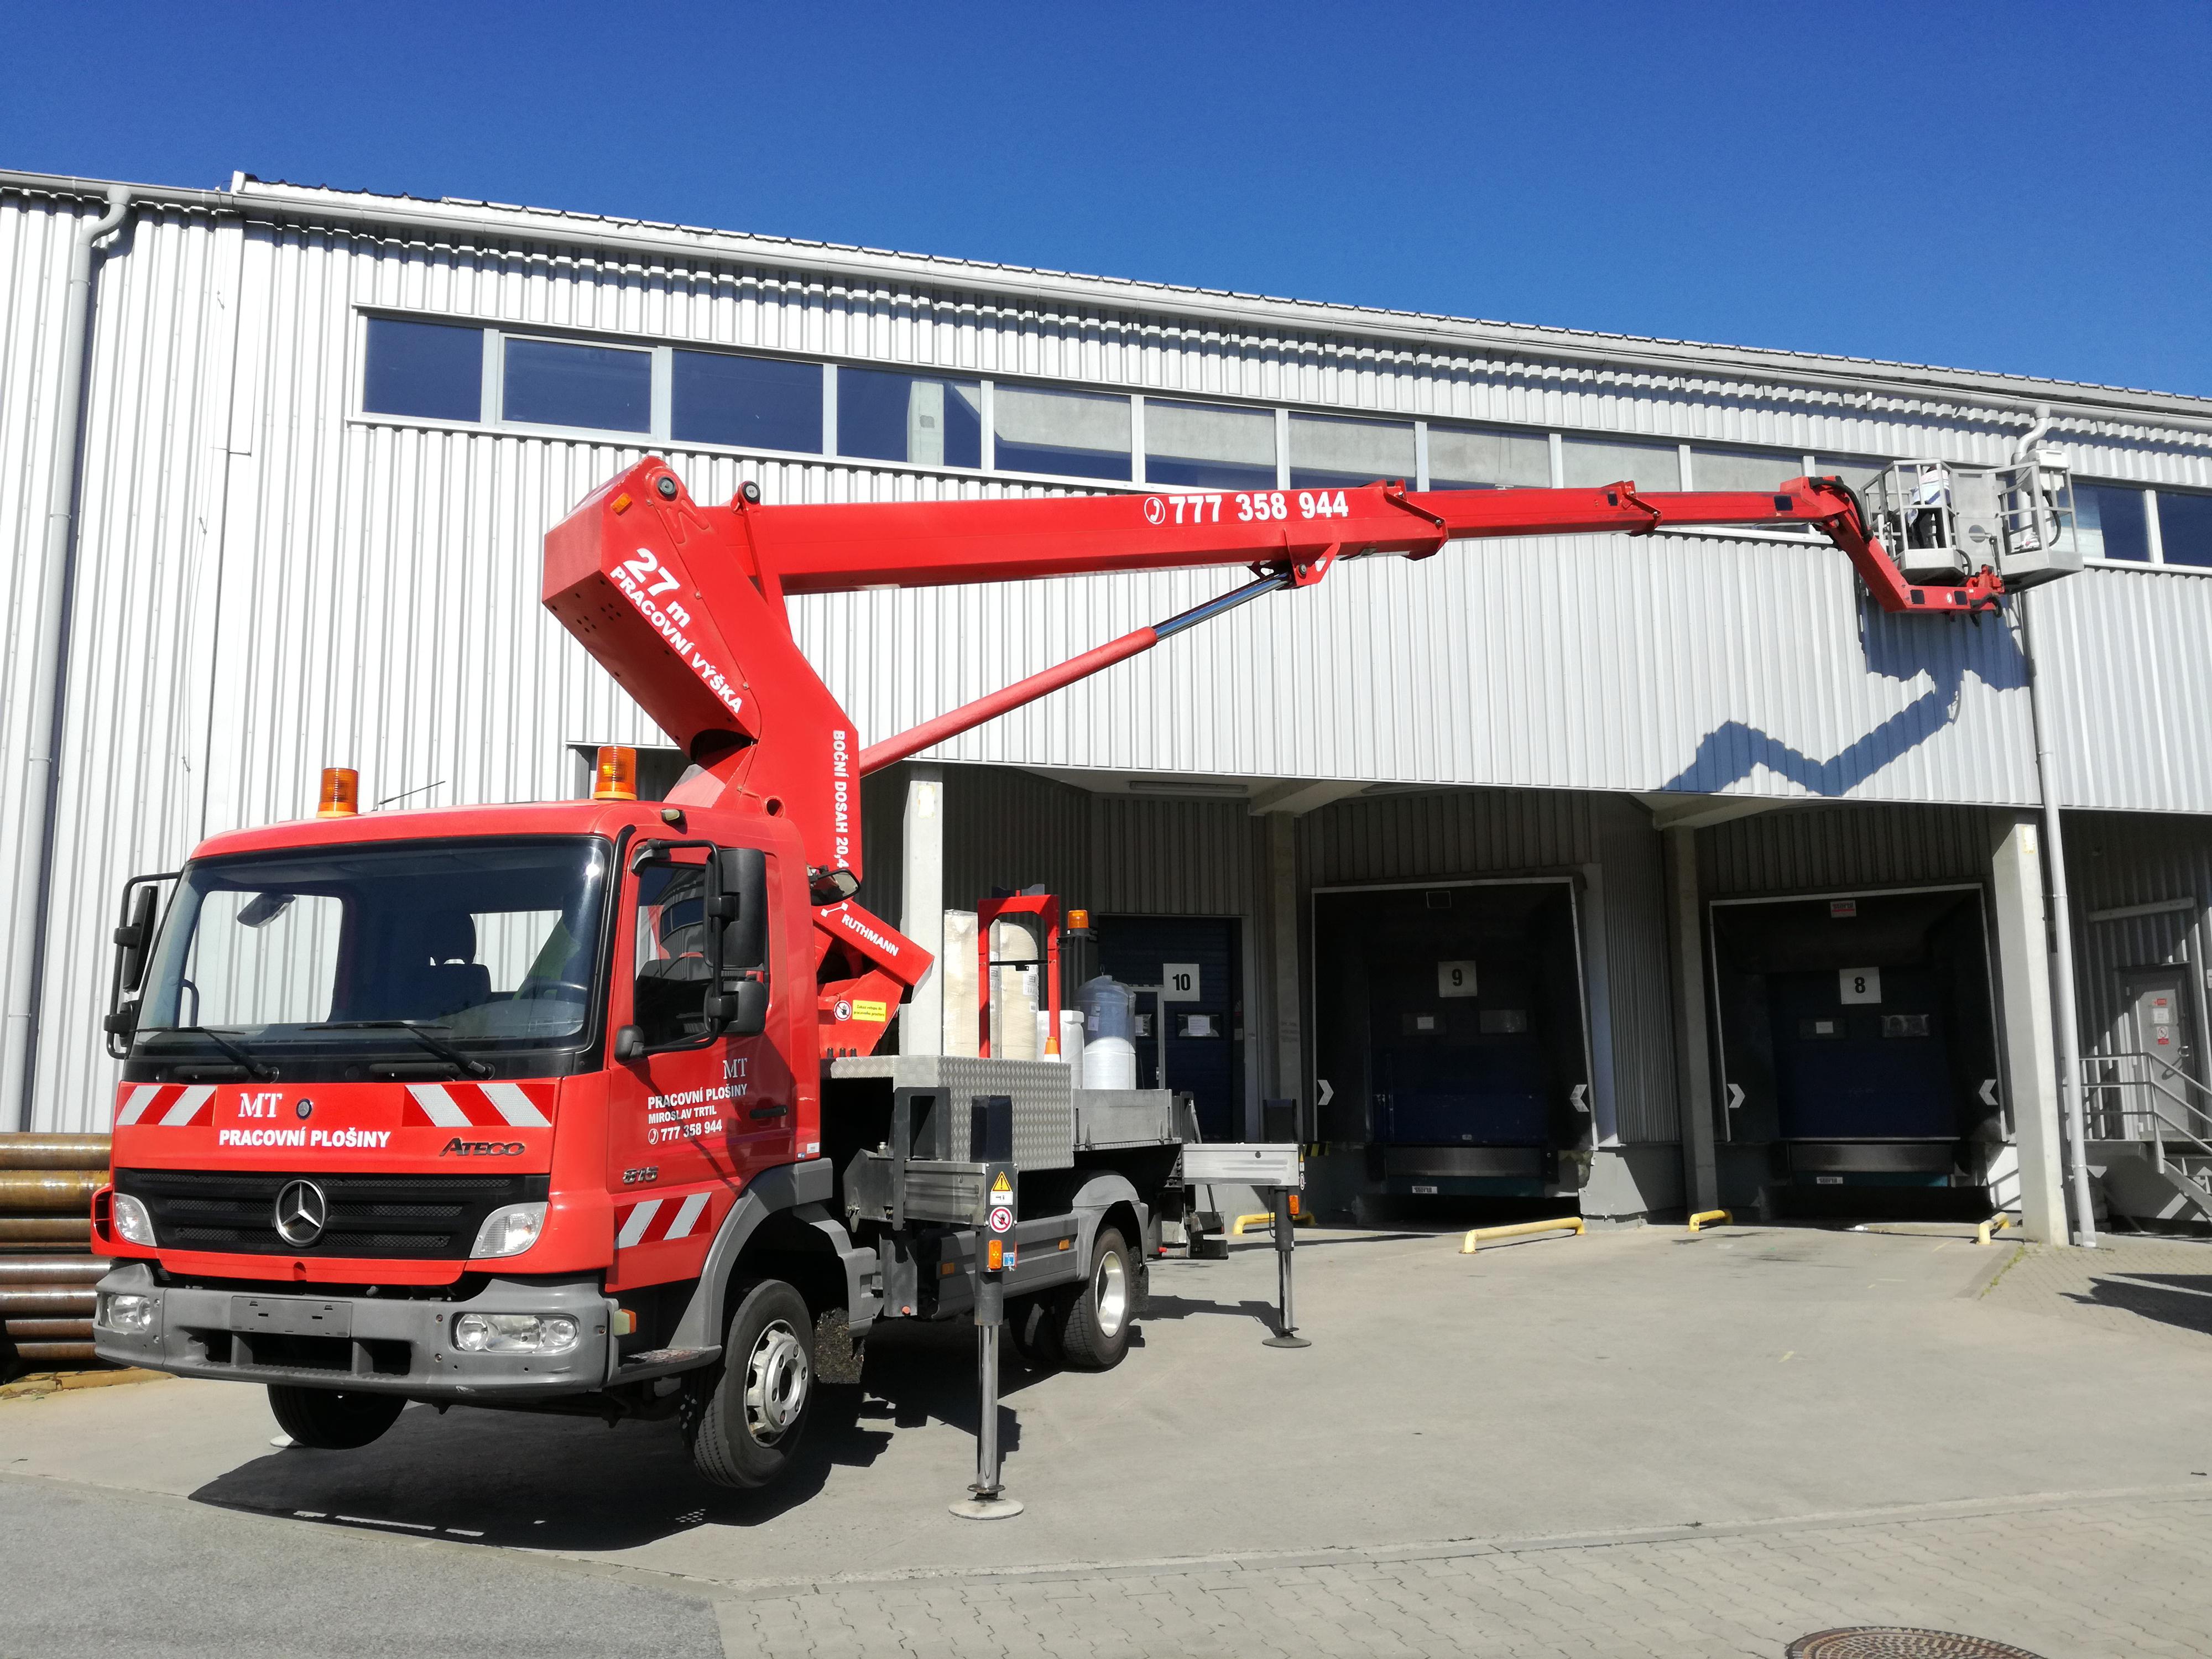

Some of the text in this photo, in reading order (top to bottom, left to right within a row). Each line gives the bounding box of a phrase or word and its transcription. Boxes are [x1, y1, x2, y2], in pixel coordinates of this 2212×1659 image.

[1168, 490, 1349, 525] 777 358 944
[623, 547, 691, 628] 27 m
[609, 566, 742, 714] PRACOVNÍ VÝŠKA
[833, 729, 850, 868] BOČNÍ DOSAH 20,4
[841, 913, 899, 957] RUTHMANN
[1172, 973, 1191, 990] 10
[1452, 968, 1463, 987] 9
[1854, 977, 1866, 994] 8
[722, 1057, 748, 1079] MT
[238, 1093, 283, 1118] MT
[648, 1083, 748, 1110] PRACOVNÍ PLOŠINY
[648, 1105, 717, 1124] MIROSLAV TRTIL
[219, 1126, 392, 1148] PRACOVNÍ PLOŠINY
[660, 1119, 723, 1141] 777 358 944
[623, 1166, 659, 1184] 815
